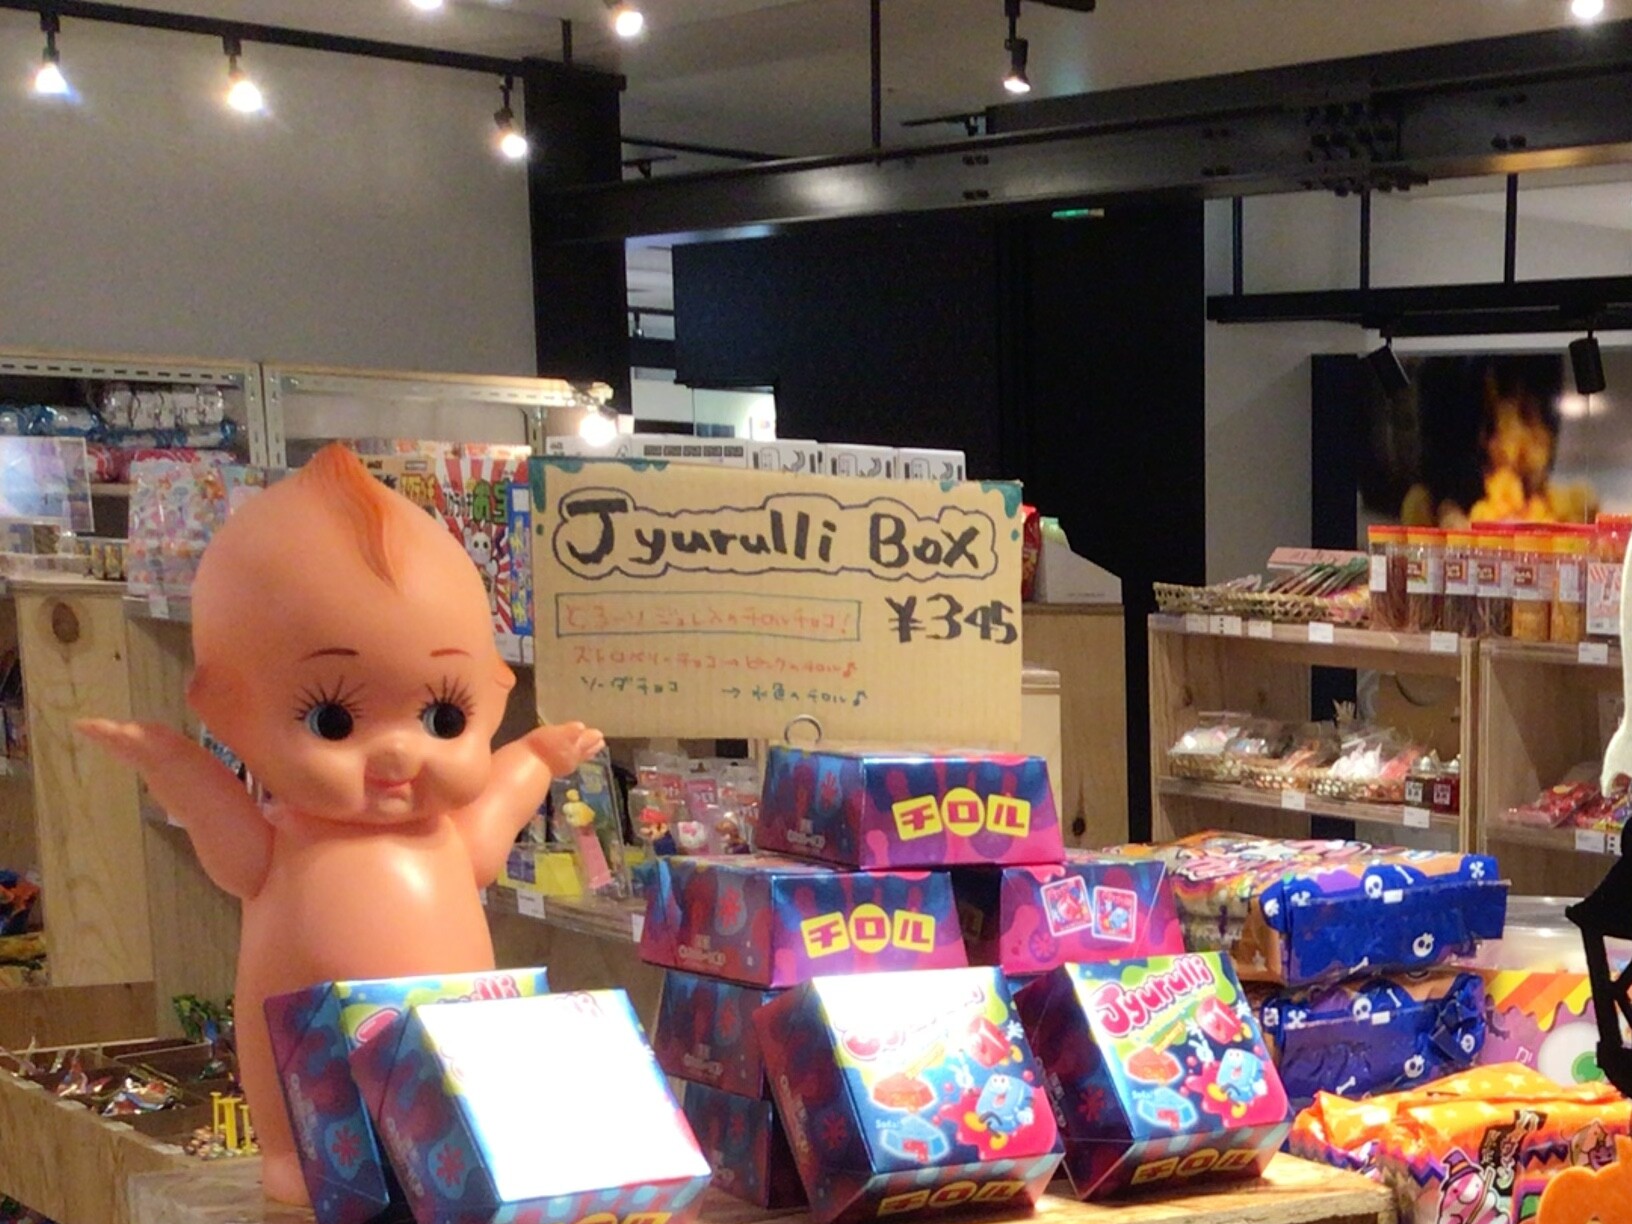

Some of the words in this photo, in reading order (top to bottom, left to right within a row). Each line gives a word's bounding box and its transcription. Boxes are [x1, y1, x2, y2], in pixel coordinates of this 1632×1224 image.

[563, 497, 838, 565] Jyurulli
[869, 511, 980, 570] Box
[884, 594, 1018, 643] ¥345
[896, 795, 1029, 836] チロル
[804, 911, 934, 953] チロル
[1095, 954, 1214, 1037] Jyurulli
